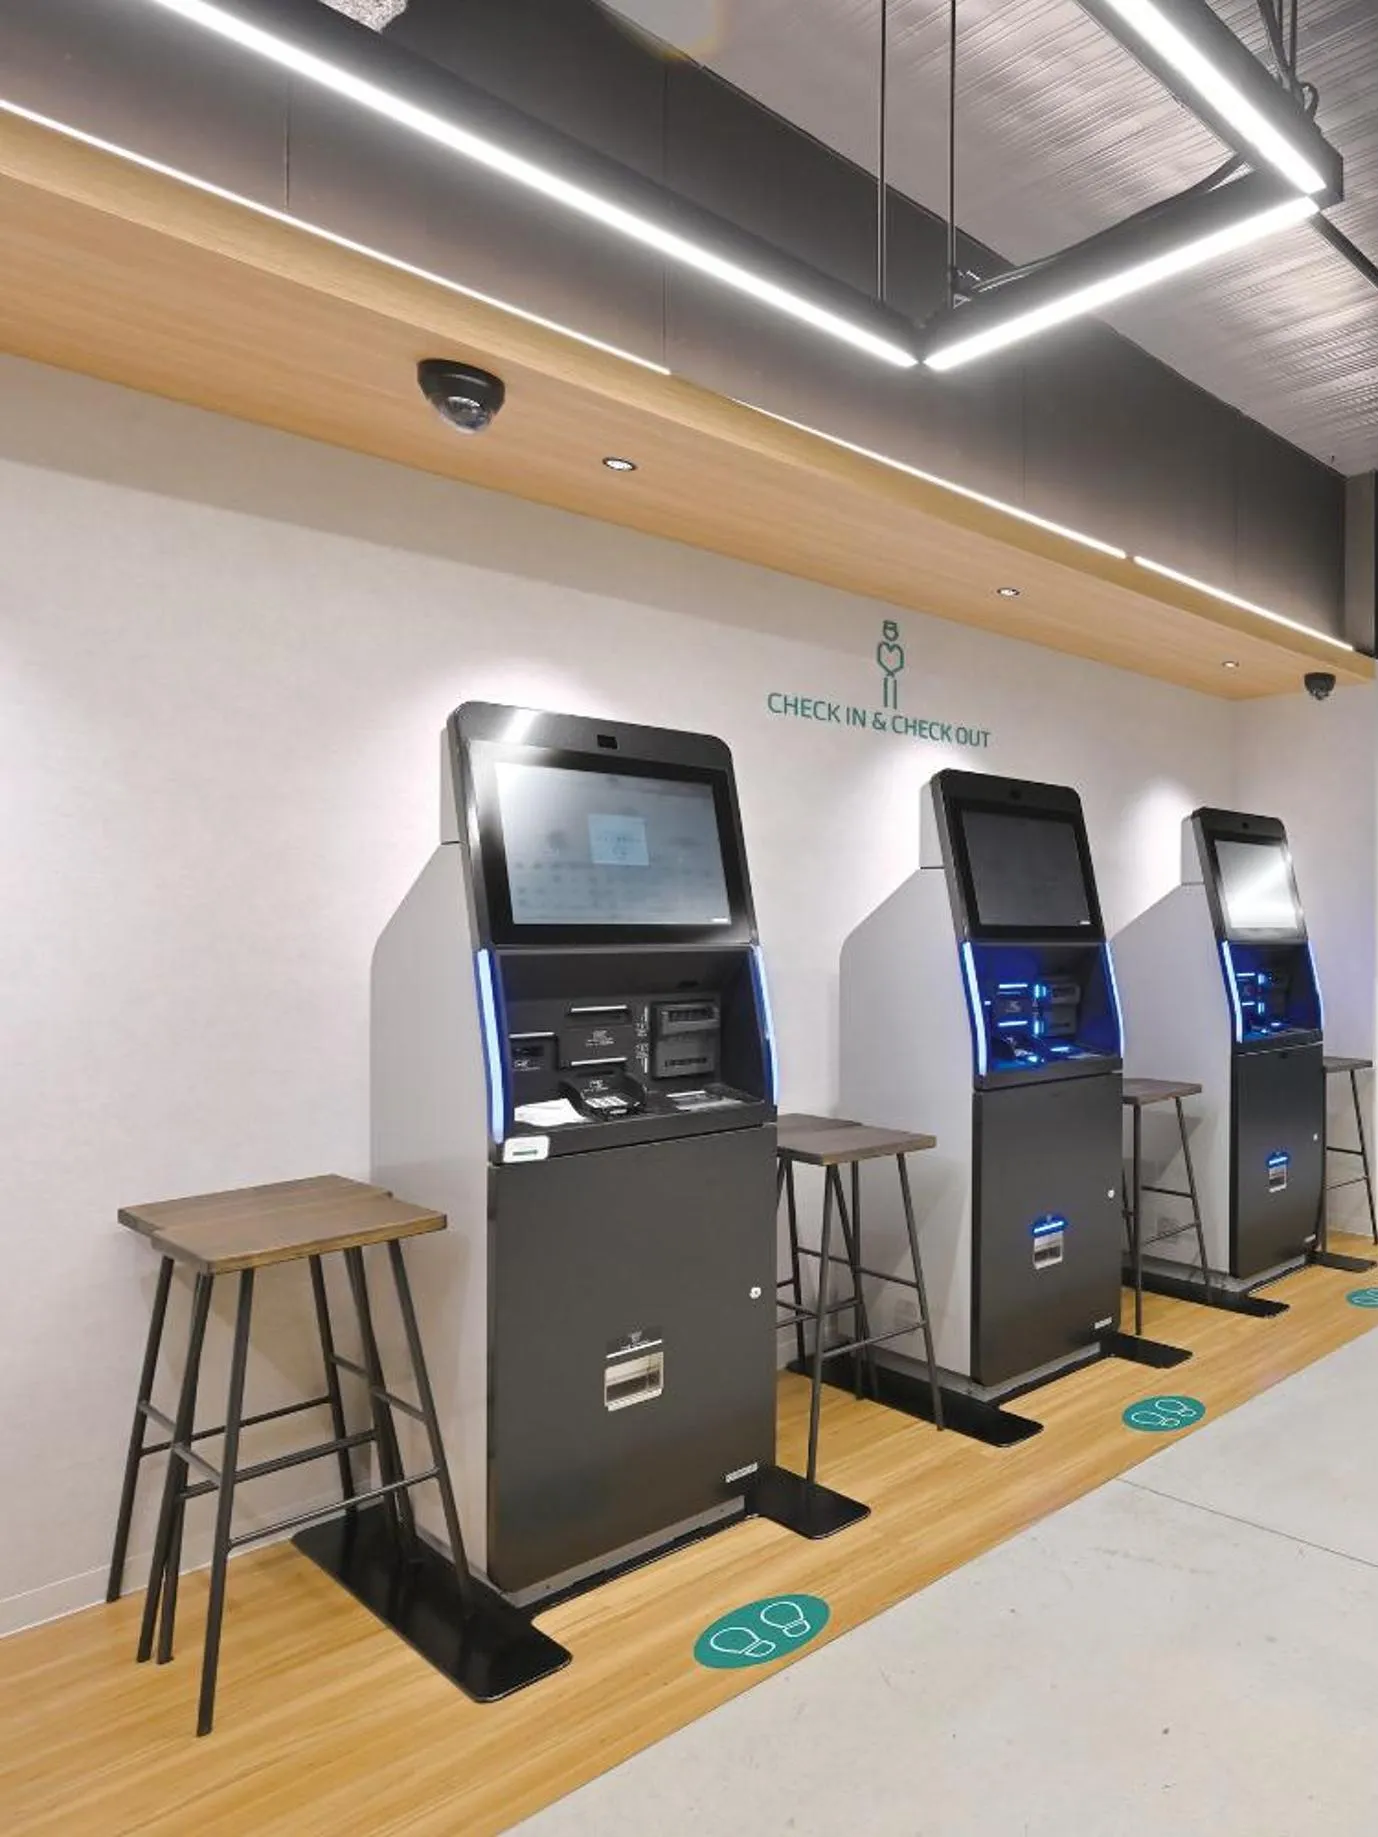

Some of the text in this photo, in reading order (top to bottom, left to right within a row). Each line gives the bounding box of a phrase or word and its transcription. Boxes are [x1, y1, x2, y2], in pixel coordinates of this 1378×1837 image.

[767, 692, 991, 747] CHECK IN & CHECK OUT
